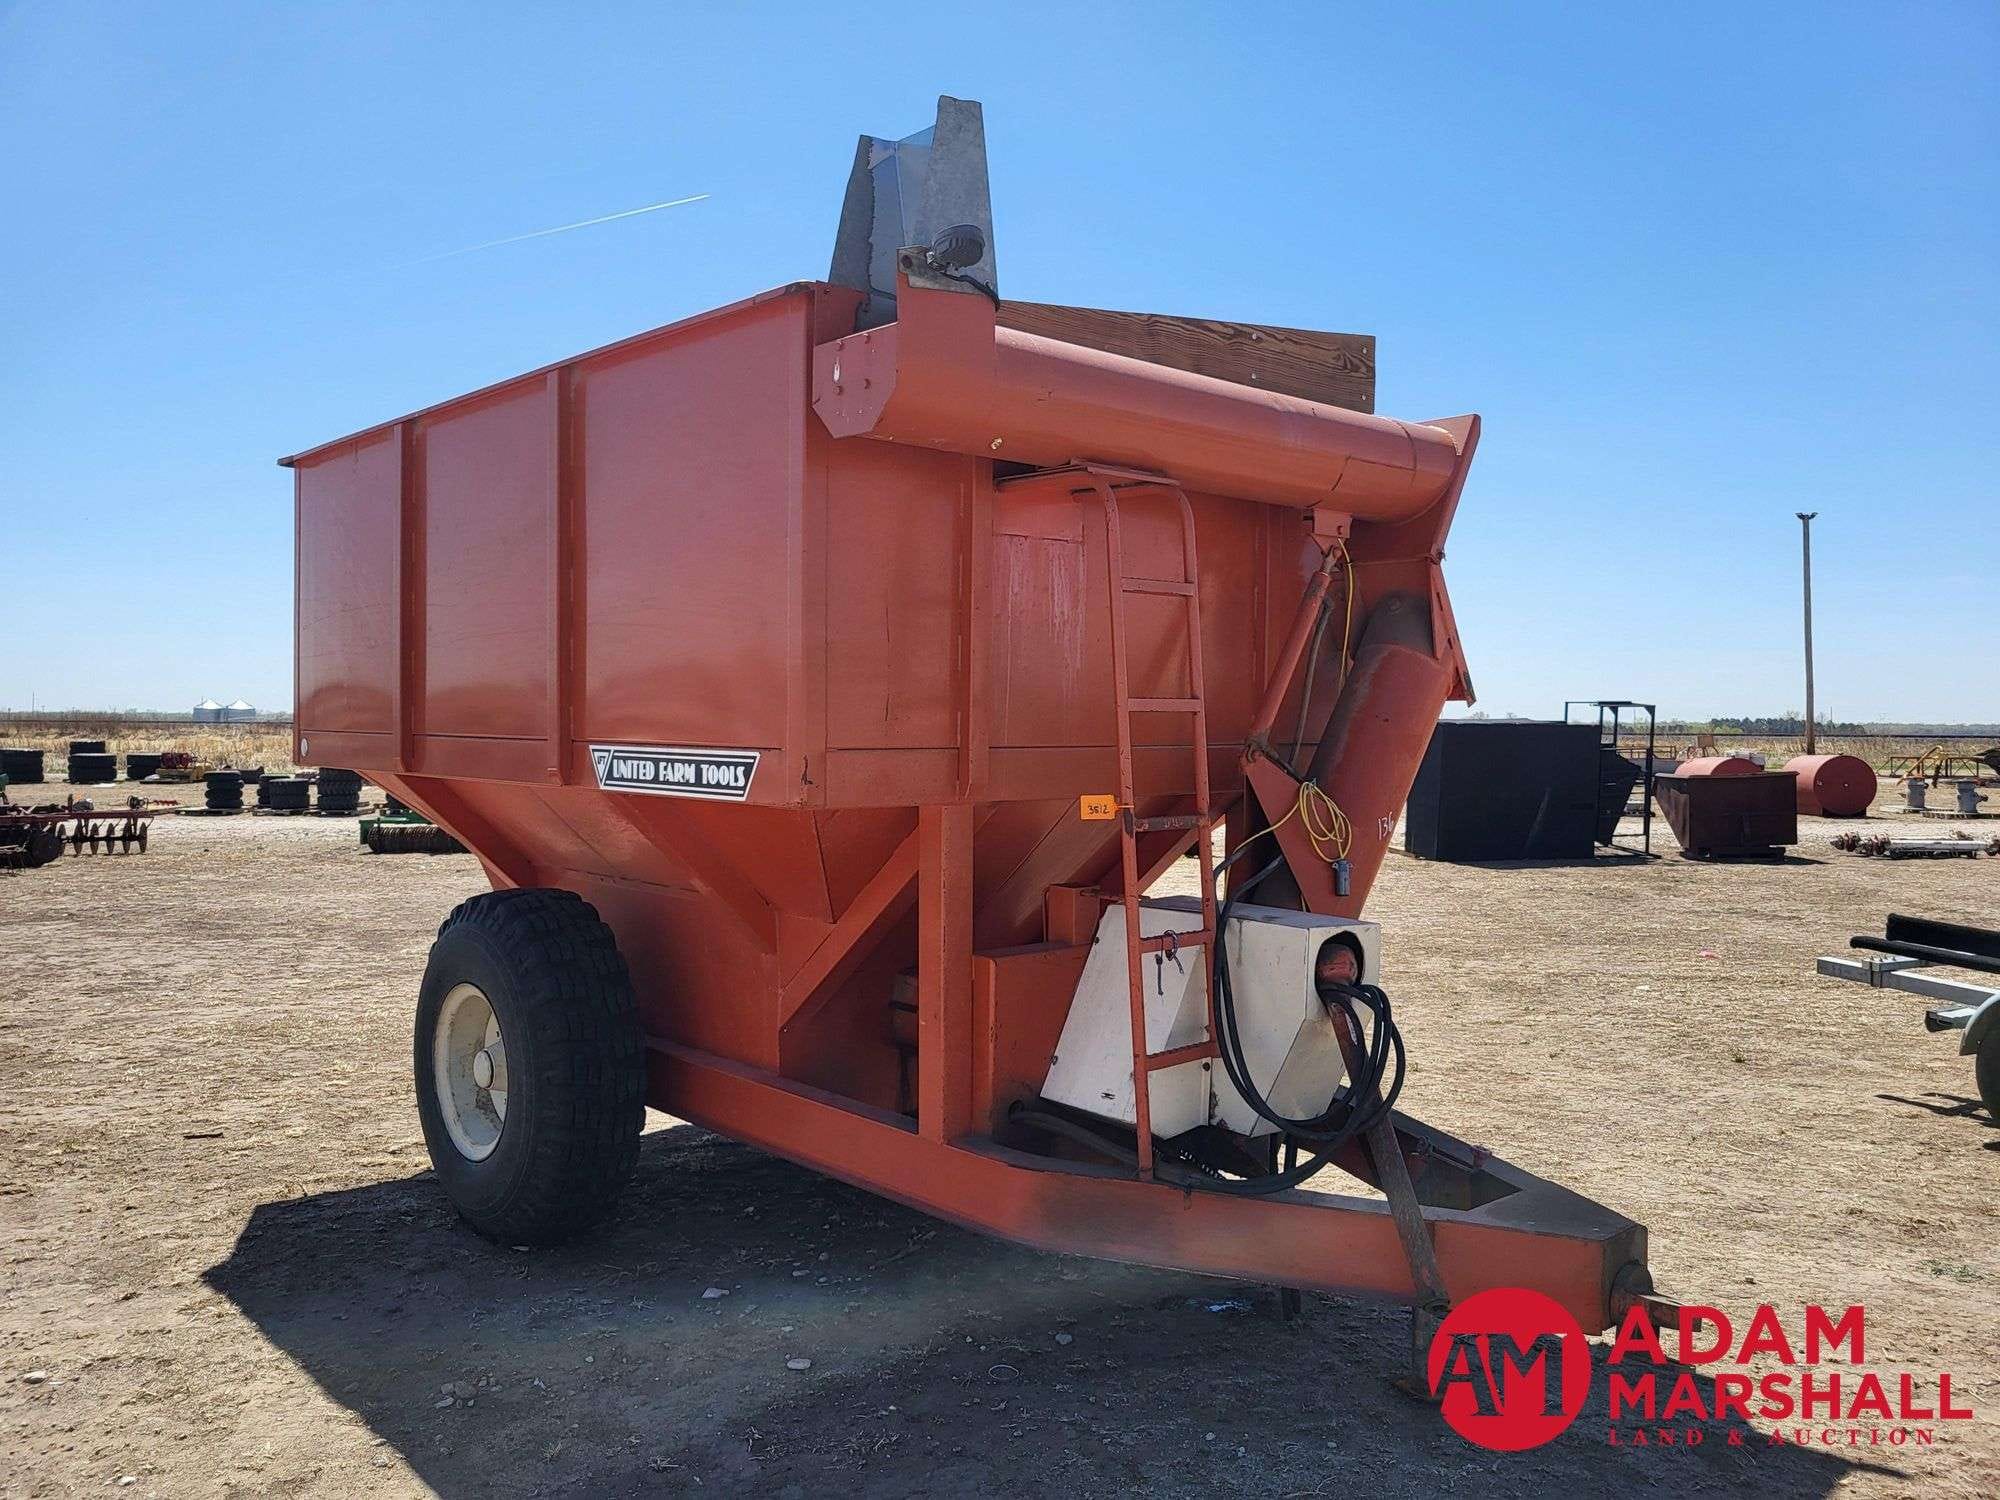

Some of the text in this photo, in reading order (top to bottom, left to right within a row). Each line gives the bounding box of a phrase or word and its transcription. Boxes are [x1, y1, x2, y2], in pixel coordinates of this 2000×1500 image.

[612, 759, 746, 787] UNITED FARM TOOLS
[1088, 804, 1110, 815] 3512
